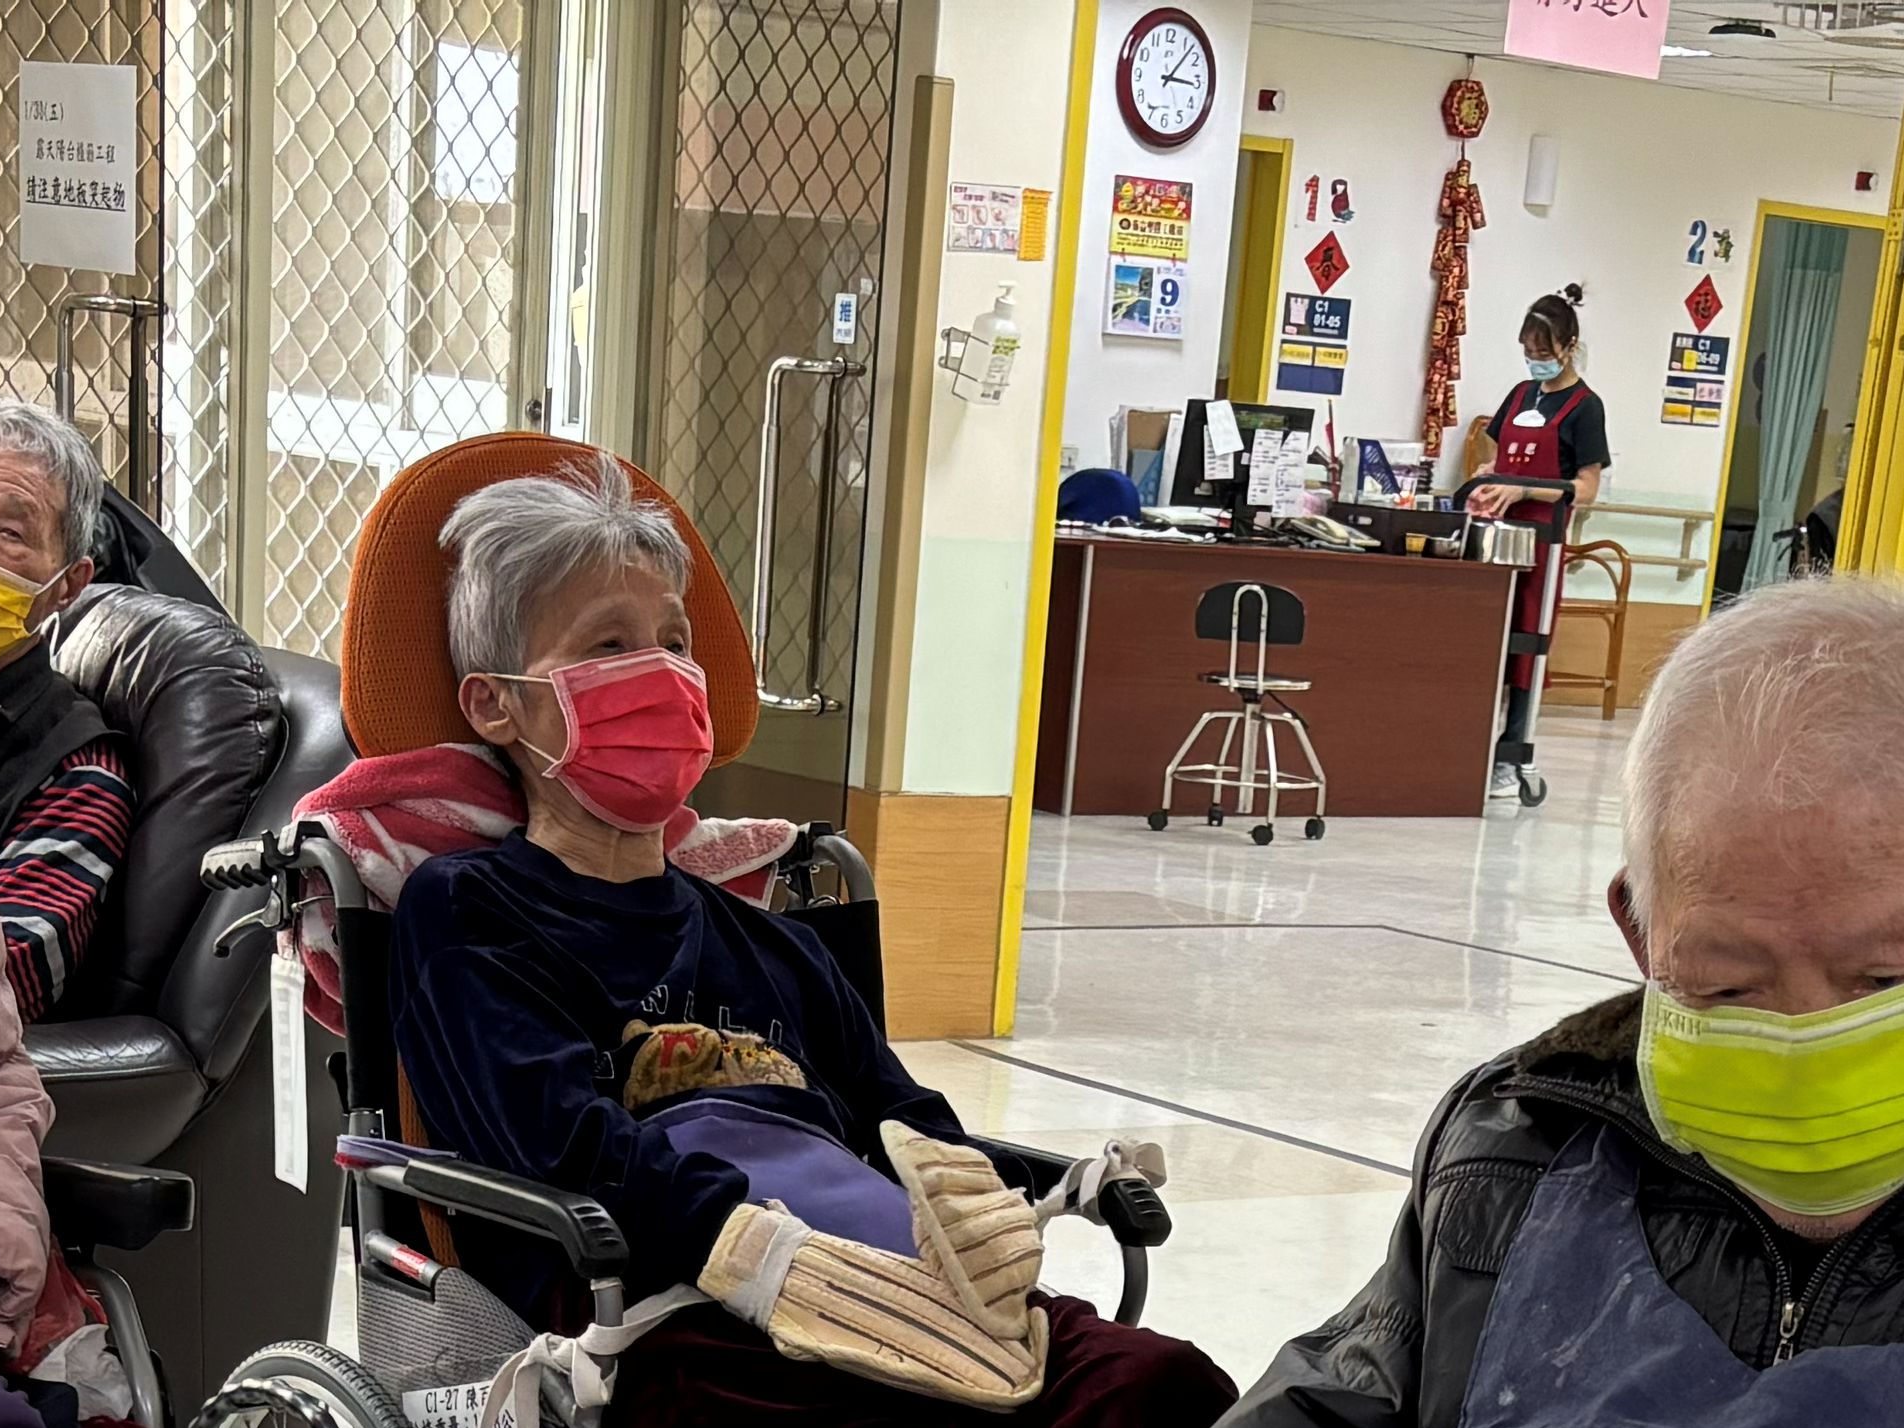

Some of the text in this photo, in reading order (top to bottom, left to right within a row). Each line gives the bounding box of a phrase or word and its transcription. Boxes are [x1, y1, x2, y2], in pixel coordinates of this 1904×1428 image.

[1151, 33, 1160, 47] 11
[1165, 28, 1176, 43] 12
[1139, 47, 1150, 62] 10
[1191, 52, 1200, 67] 2
[1134, 67, 1142, 82] 9
[1193, 74, 1201, 89] 3
[1137, 88, 1145, 104] 8
[1187, 96, 1194, 109] 4
[1147, 102, 1156, 120] 7
[1175, 110, 1183, 124] 5
[1160, 113, 1168, 128] 6
[1686, 220, 1707, 265] 2
[1313, 246, 1340, 282] 春
[1160, 278, 1180, 307] 9
[1315, 300, 1329, 314] C1
[1313, 313, 1342, 329] 01-05
[1698, 338, 1711, 351] C1
[425, 1388, 459, 1414] C1-27
